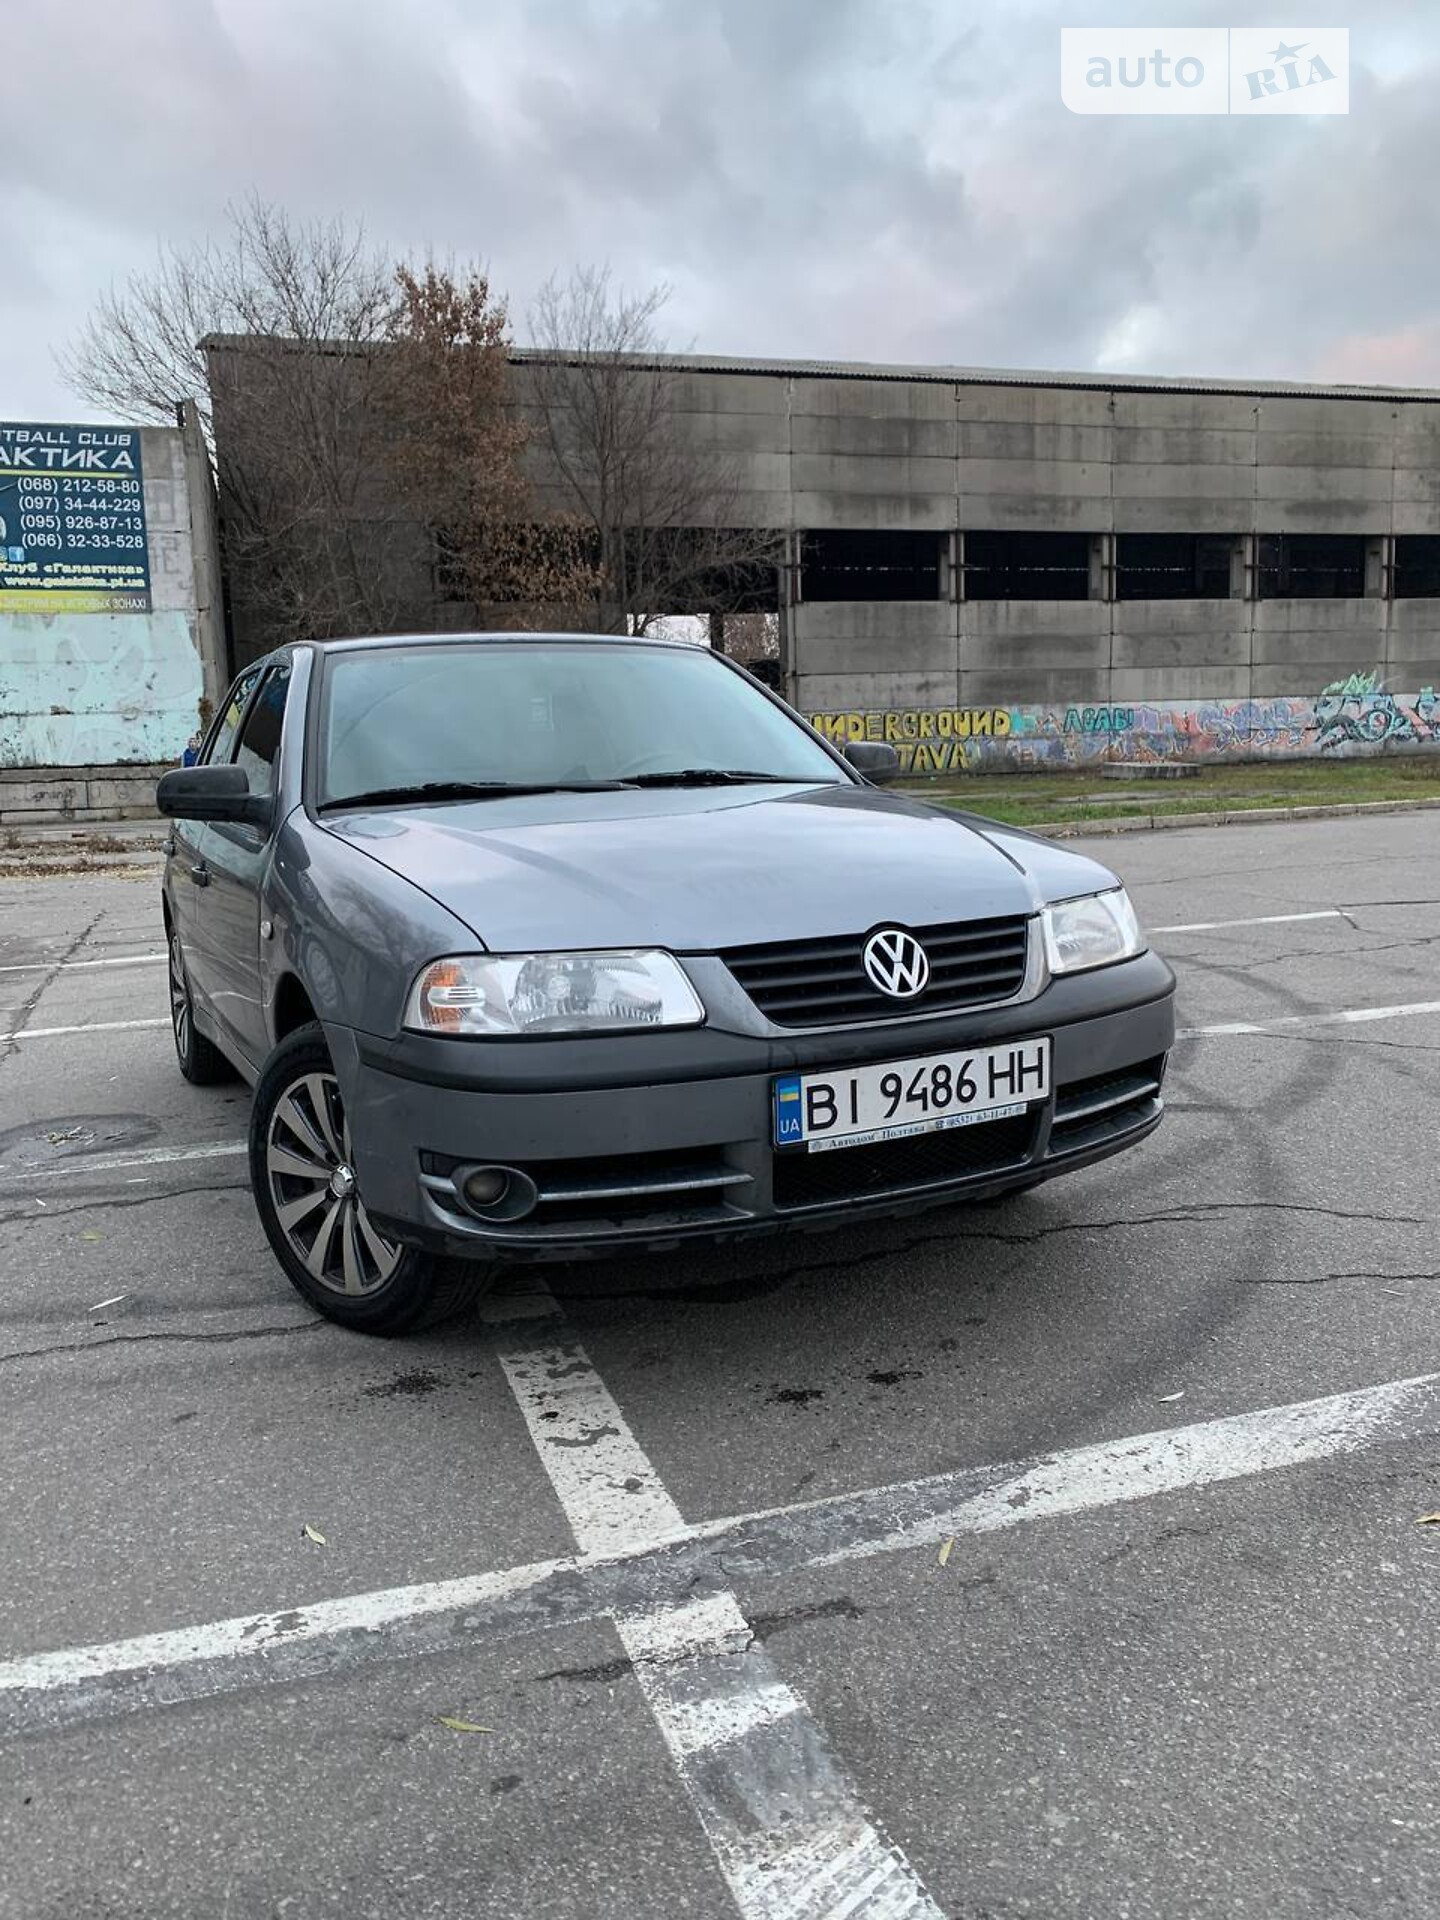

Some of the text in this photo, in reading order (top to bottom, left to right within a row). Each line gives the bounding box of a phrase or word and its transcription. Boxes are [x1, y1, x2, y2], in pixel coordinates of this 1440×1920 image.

[78, 432, 131, 446] CLUB
[17, 477, 139, 494] (068) 212-58-80
[19, 496, 141, 513] (097) 34-44-229
[20, 514, 142, 531] (095) 926-87-13
[22, 533, 144, 549] (066) 32-33-528
[893, 738, 971, 772] TAVA
[879, 1058, 977, 1119] 9486
[987, 1046, 1045, 1099] HH
[780, 1119, 800, 1135] UA
